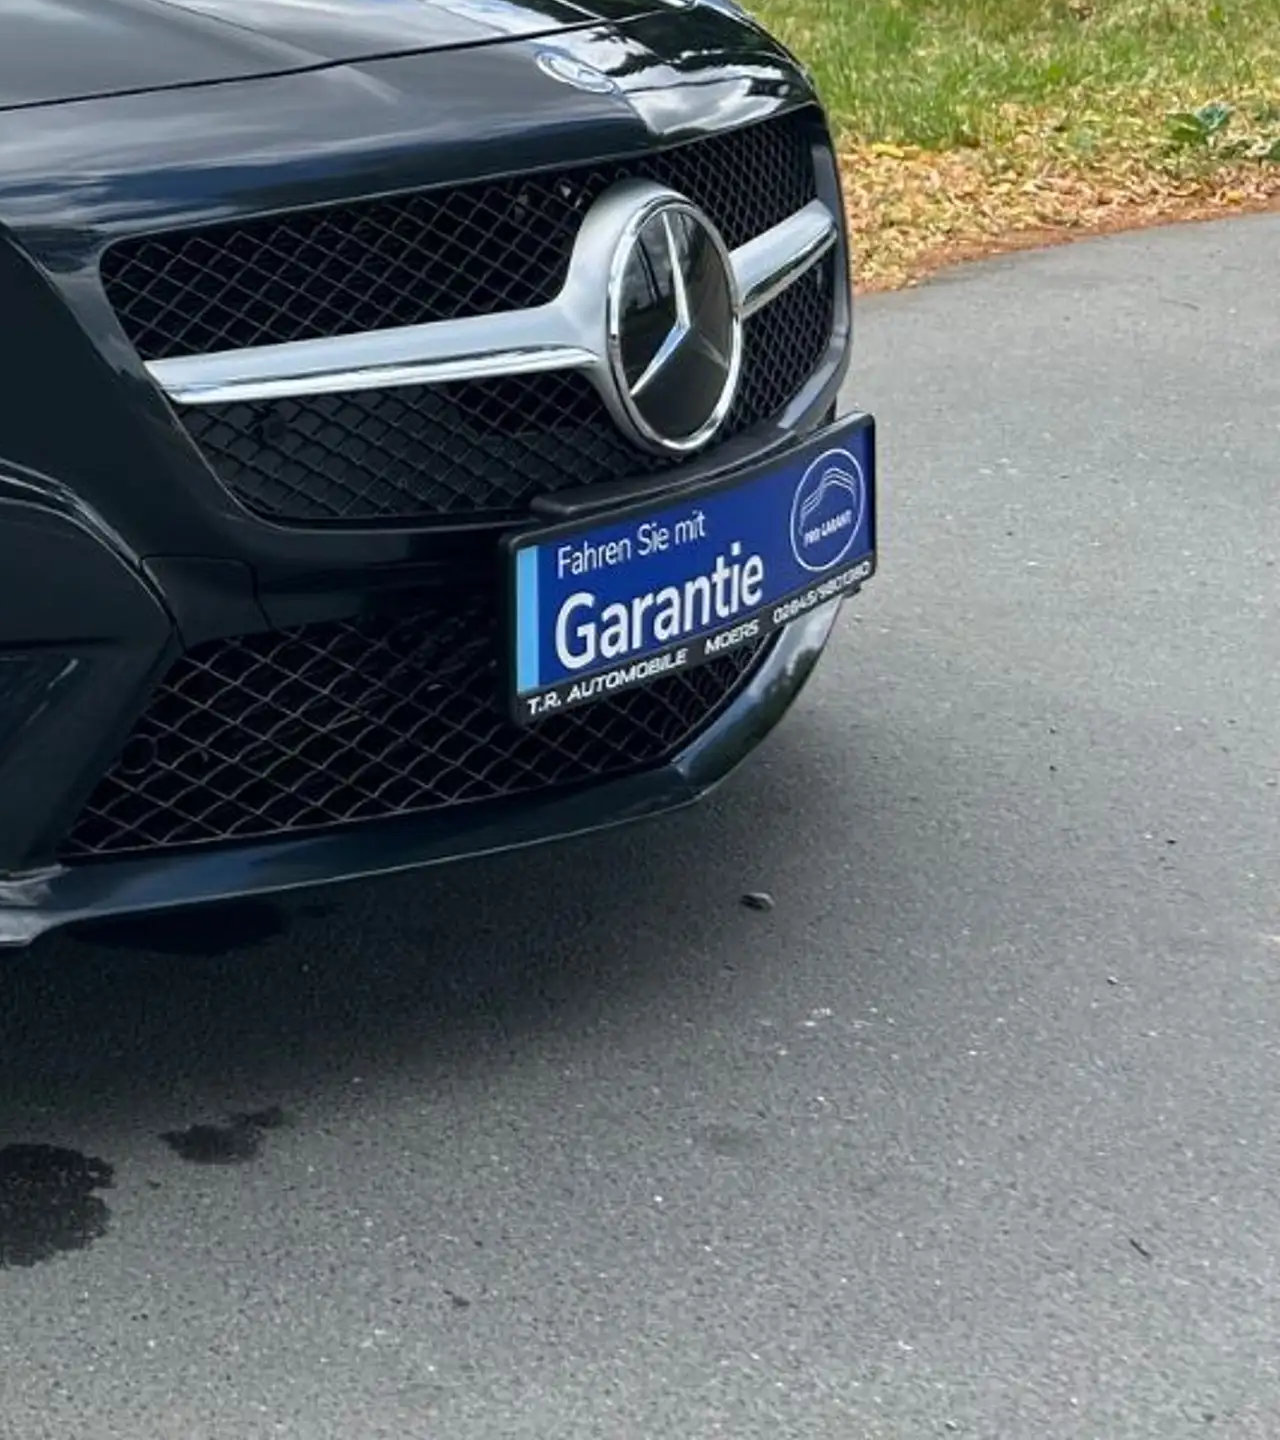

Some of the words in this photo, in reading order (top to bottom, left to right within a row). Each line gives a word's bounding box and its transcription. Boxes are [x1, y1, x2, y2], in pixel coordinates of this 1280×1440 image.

[557, 537, 632, 579] Fahren
[636, 521, 670, 556] Sie
[675, 510, 706, 545] mit
[555, 541, 765, 670] Garantie
[526, 691, 561, 715] T.R.
[566, 647, 688, 703] AUTOMOBILE
[703, 618, 760, 655] MOERS
